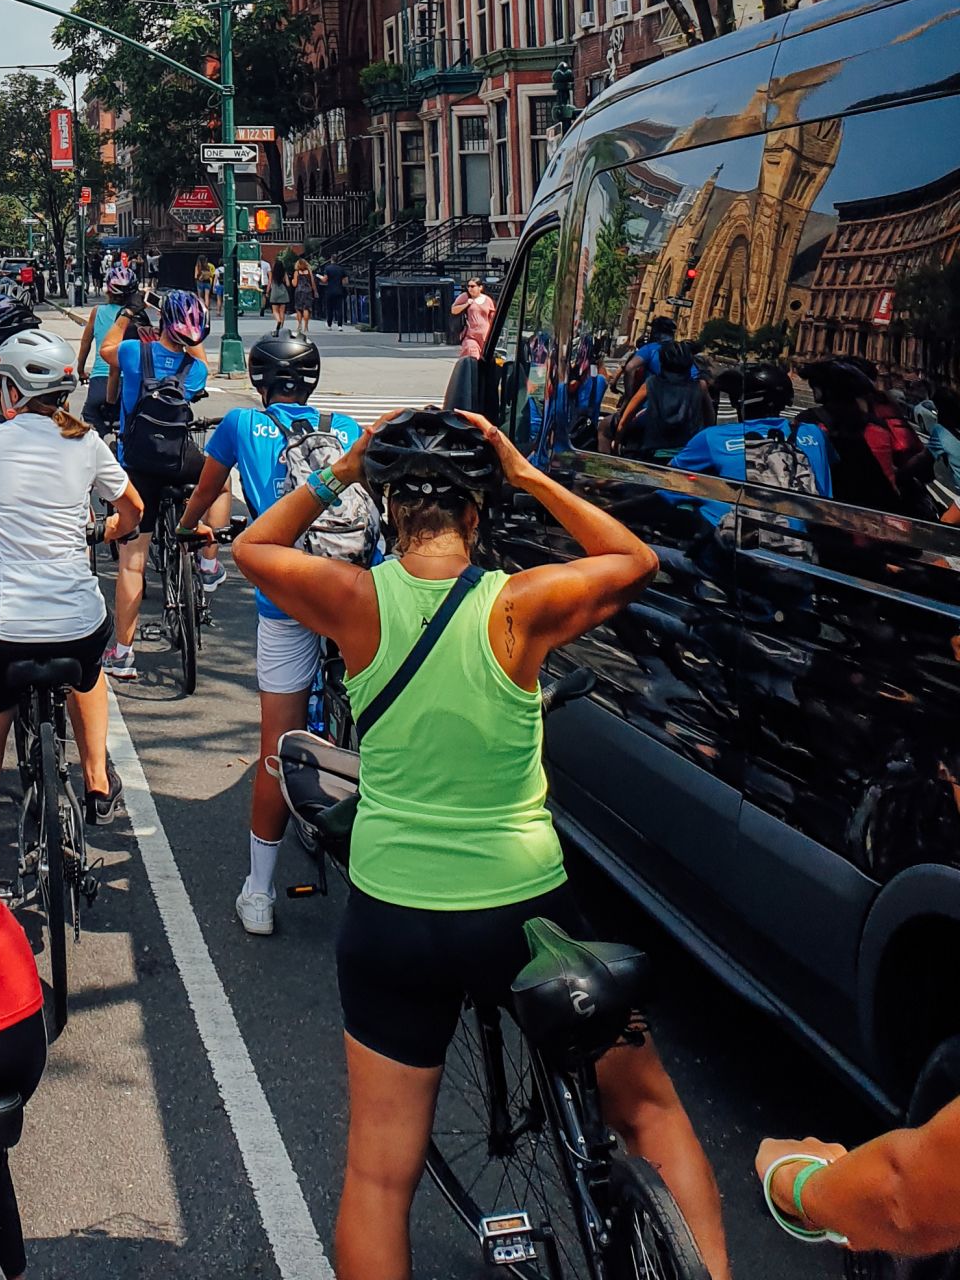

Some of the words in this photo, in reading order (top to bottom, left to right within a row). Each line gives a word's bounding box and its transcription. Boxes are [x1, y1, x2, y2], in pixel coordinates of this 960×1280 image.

[238, 129, 245, 140] W
[247, 129, 259, 140] 122
[262, 129, 272, 140] ST
